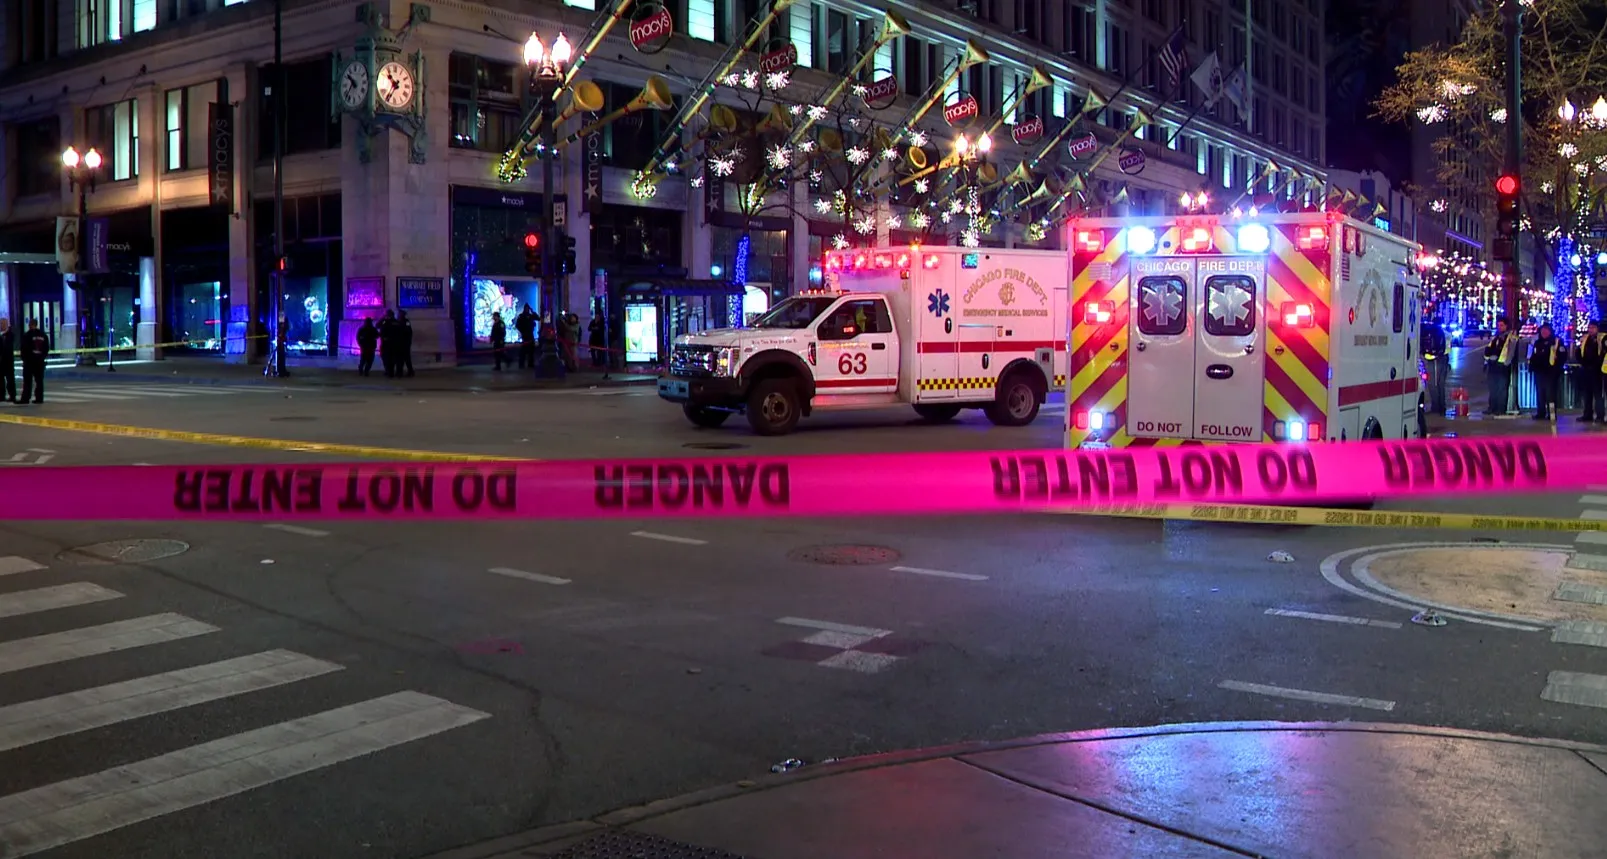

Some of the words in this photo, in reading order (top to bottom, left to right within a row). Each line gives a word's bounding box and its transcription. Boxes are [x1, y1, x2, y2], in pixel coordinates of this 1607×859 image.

[632, 13, 670, 42] macy's
[945, 100, 976, 118] macy's
[1013, 121, 1042, 138] macy's
[963, 269, 1002, 304] CHICAGO
[1004, 268, 1026, 283] FIRE
[1136, 261, 1190, 272] CHICAGO
[1199, 260, 1226, 271] FIRE
[838, 353, 867, 375] 63
[1137, 421, 1154, 432] DO
[1157, 422, 1182, 433] NOT
[1201, 424, 1253, 437] FOLLOW
[594, 461, 791, 510] DANGER
[989, 453, 1137, 503] ENTER
[1153, 451, 1243, 499] NOT
[1256, 447, 1318, 495] DO
[1377, 440, 1547, 489] DANGER
[173, 467, 324, 513] ENTER
[338, 468, 434, 513] NOT
[451, 469, 518, 513] DO
